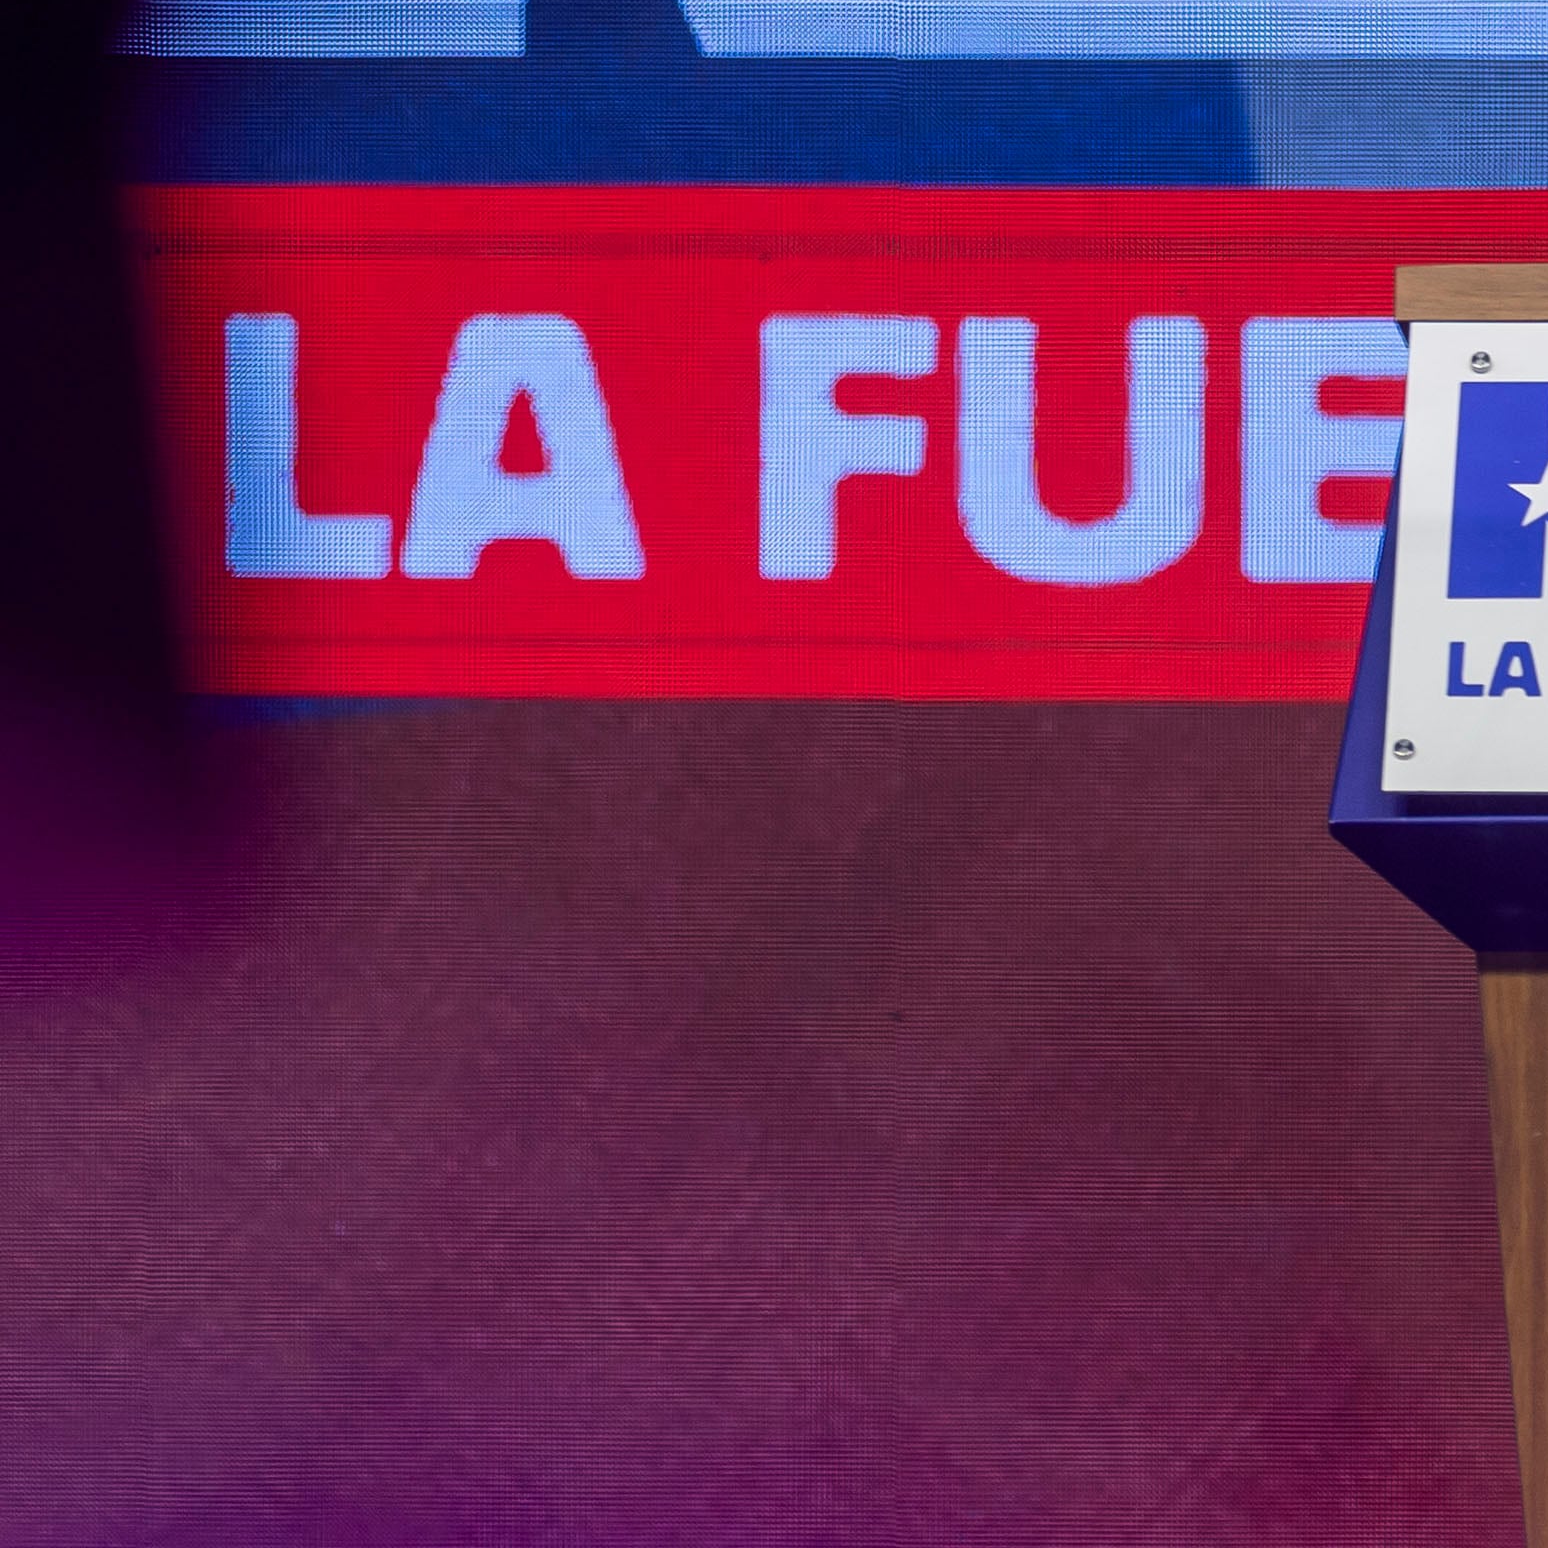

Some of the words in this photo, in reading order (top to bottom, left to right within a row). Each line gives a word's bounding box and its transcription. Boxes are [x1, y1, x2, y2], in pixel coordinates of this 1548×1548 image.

[225, 313, 645, 579] LA
[759, 314, 1406, 586] FUE
[1446, 641, 1541, 698] LA
